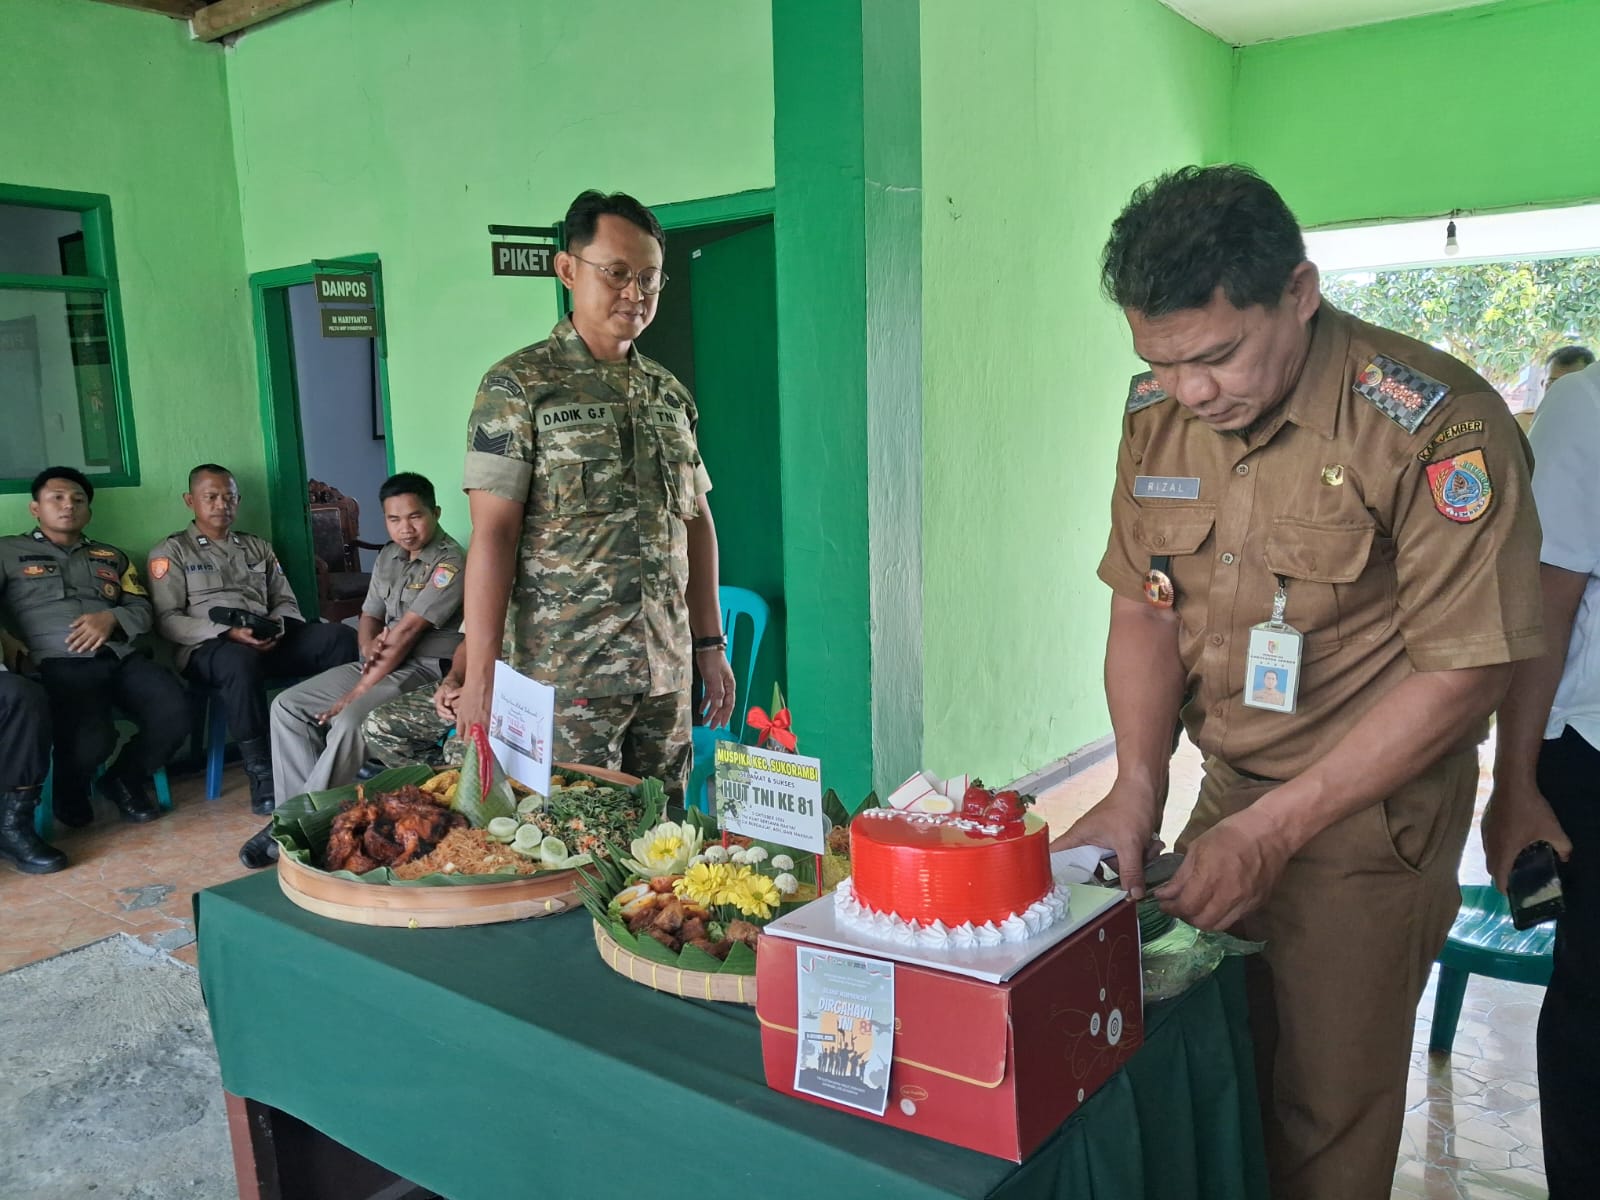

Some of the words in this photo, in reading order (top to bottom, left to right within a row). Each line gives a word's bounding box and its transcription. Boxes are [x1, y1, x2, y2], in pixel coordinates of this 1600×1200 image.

[499, 247, 550, 271] PIKET
[321, 280, 367, 298] DANPOS
[543, 409, 582, 426] DADIK
[656, 411, 678, 424] TNI
[1439, 421, 1481, 442] JEMBER
[1147, 482, 1184, 493] RIZAL
[717, 748, 751, 767] MUSPIKA
[752, 756, 770, 771] KEC.
[771, 760, 818, 781] SUKORAMBI
[773, 778, 795, 788] SUKSES
[723, 781, 749, 801] HUT
[752, 787, 774, 808] TNI
[778, 792, 794, 812] KE
[798, 797, 813, 816] 81
